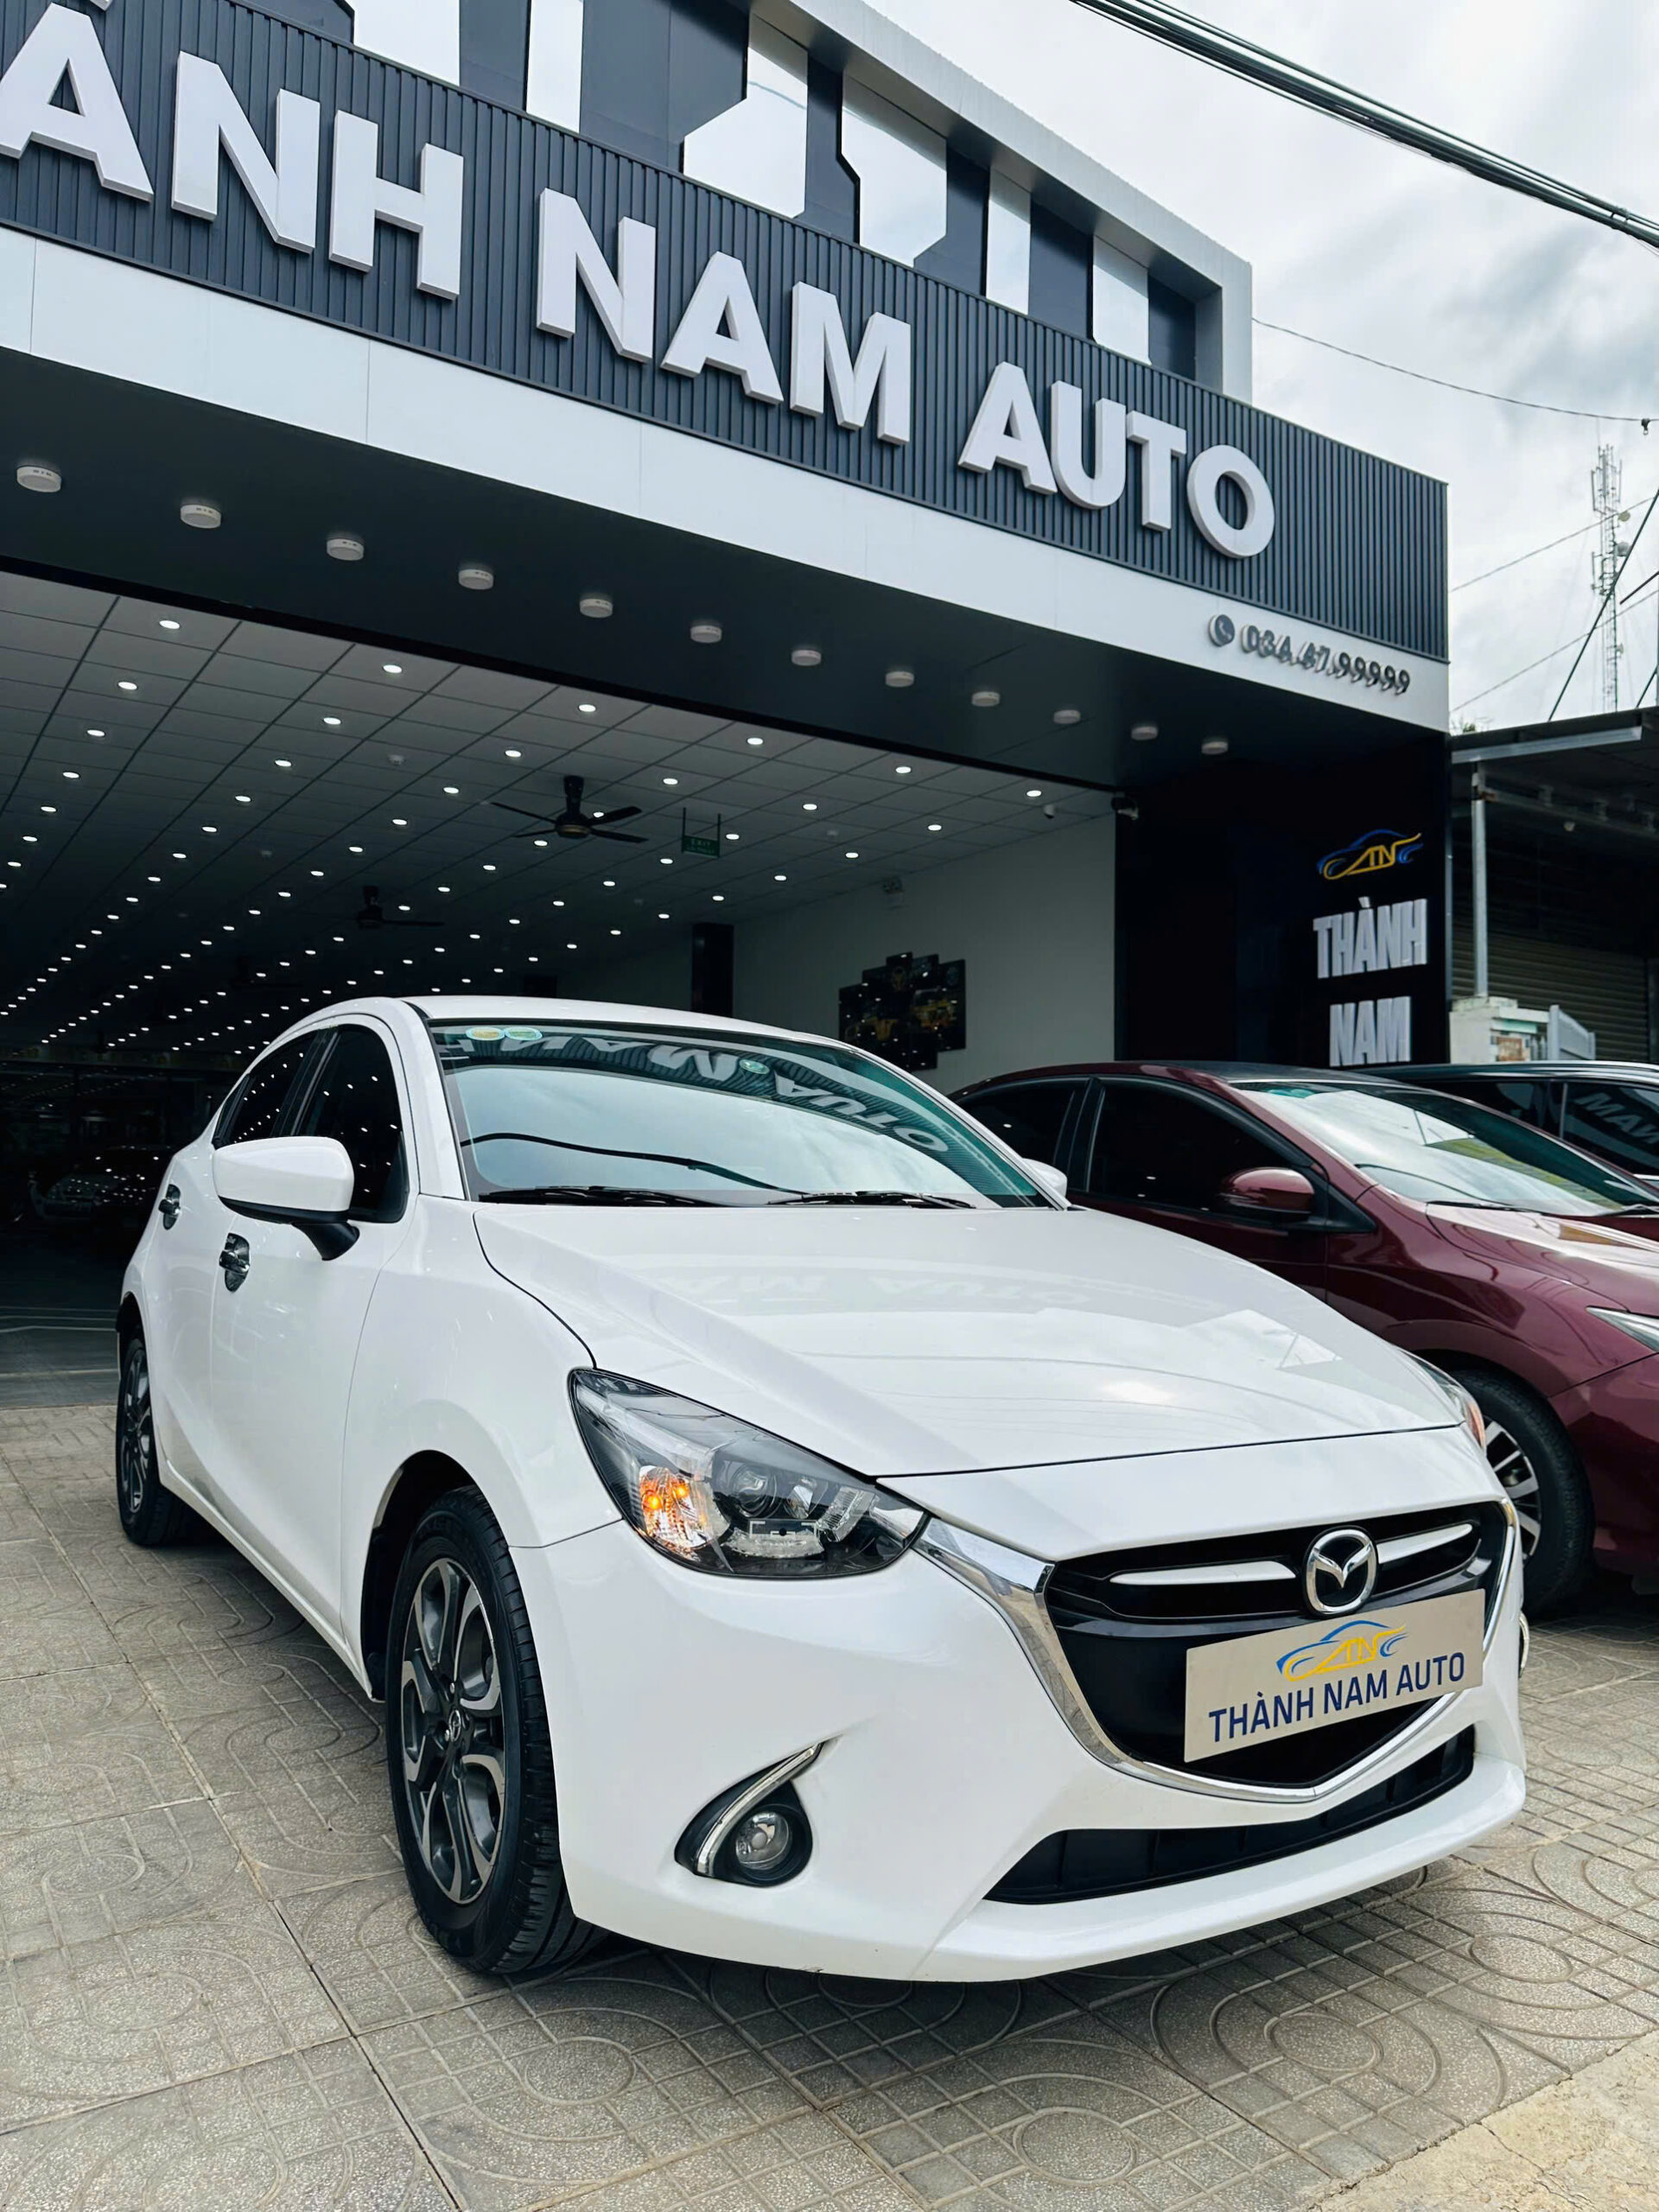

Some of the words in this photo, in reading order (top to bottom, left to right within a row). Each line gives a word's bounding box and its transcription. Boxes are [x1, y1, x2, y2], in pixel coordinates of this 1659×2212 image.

[536, 188, 911, 445] NAM
[957, 361, 1275, 558] AUTO
[1313, 896, 1427, 979] THÀNH
[1330, 995, 1412, 1068] NAM
[1209, 1686, 1315, 1743] THÀNH
[1324, 1669, 1388, 1714] NAM
[1395, 1651, 1465, 1694] AUTO
